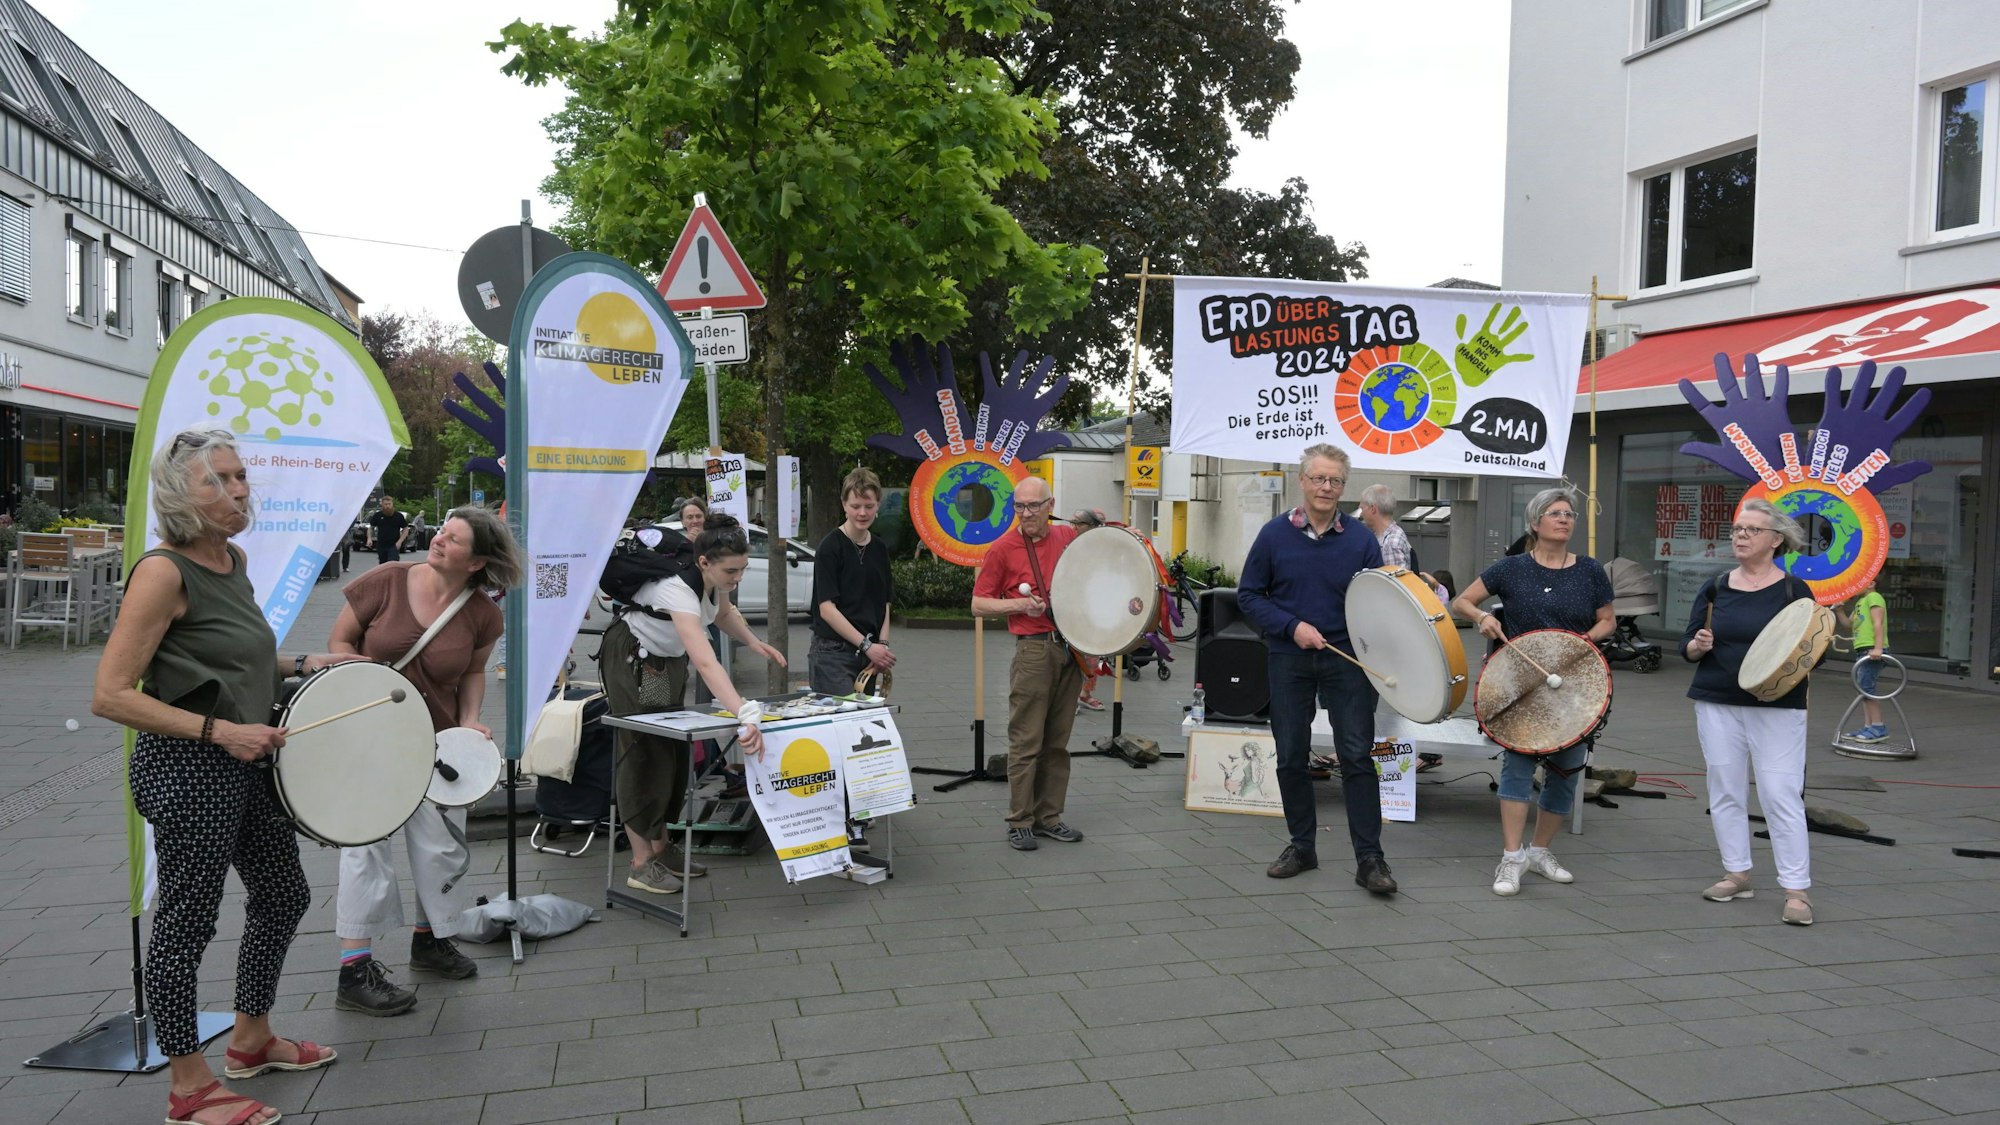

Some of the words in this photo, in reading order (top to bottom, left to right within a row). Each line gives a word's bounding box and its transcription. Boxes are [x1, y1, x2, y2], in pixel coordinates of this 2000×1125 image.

[686, 325, 736, 339] raßen-
[1206, 299, 1271, 337] ERD
[1276, 301, 1339, 323] ÜBER-
[1341, 310, 1413, 346] TAG
[536, 327, 590, 343] INITIATIVE
[1233, 324, 1340, 353] LASTUNGS
[536, 343, 662, 368] KLIMAGERECHT
[1474, 347, 1489, 361] INS
[1477, 335, 1501, 358] KOMM
[1281, 346, 1346, 373] 2024
[1458, 346, 1492, 376] HANDELN
[613, 367, 661, 384] LEBEN
[1257, 384, 1319, 408] SOS!!!
[939, 390, 965, 454] HANDELN
[975, 403, 990, 450] BESTIMMT
[1228, 416, 1251, 429] Die
[1257, 411, 1289, 425] Erde
[1295, 409, 1313, 421] ist
[1470, 410, 1538, 443] 2.MAI
[993, 420, 1012, 451] UNSERE
[1256, 423, 1328, 440] erschöpft.
[916, 430, 941, 458] MEIN
[1000, 422, 1029, 465] ZUKUNFT
[1815, 430, 1829, 457] NOCH
[271, 456, 344, 473] Rhein-Berg
[349, 462, 371, 472] e.V.
[536, 453, 561, 464] EINE
[566, 454, 626, 466] EINLADUNG
[1464, 451, 1546, 471] Deutschland
[1725, 423, 1782, 489] GEMEINSAM
[1782, 433, 1802, 482] KÖNNEN
[1823, 446, 1848, 483] VIELES
[722, 461, 742, 472] TAG
[1811, 458, 1822, 478] WIR
[1840, 450, 1888, 494] RETTEN
[1657, 486, 1679, 502] WIR
[1701, 485, 1725, 502] WIR
[261, 497, 335, 515] denken,
[1656, 503, 1689, 521] SEHEN
[252, 517, 327, 532] handeln
[1656, 521, 1676, 539] ROT
[1700, 522, 1721, 540] ROT
[283, 558, 316, 603] alle!
[1392, 744, 1411, 755] TAG
[756, 770, 836, 795] KMAGERECHT
[768, 770, 790, 780] IATIVE
[804, 782, 836, 795] LEBEN
